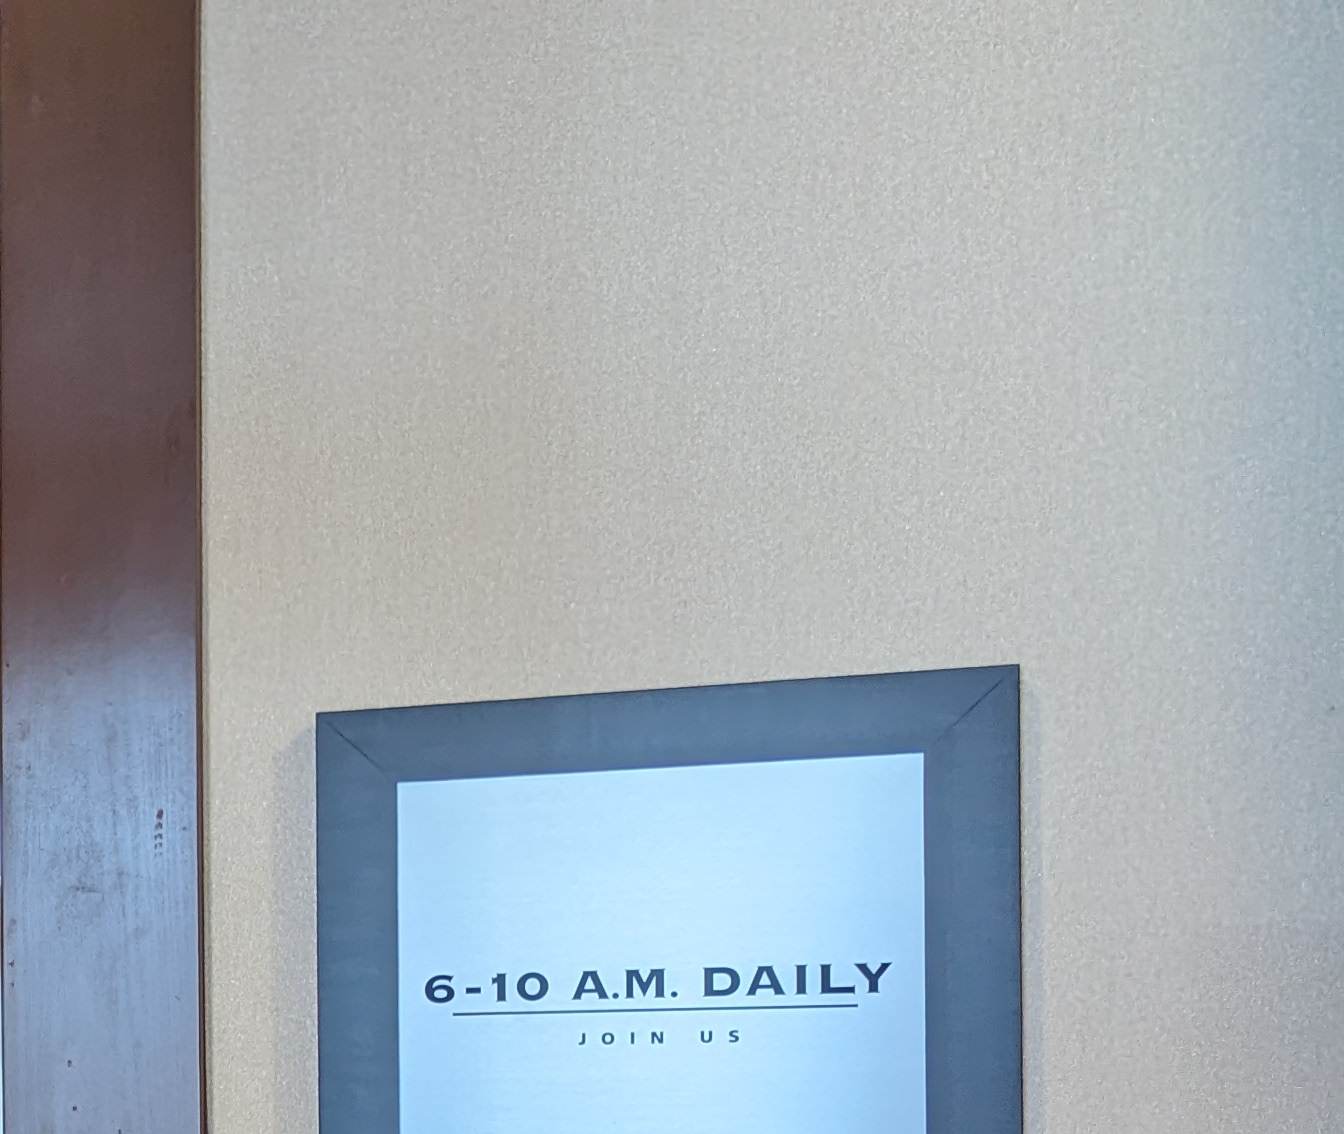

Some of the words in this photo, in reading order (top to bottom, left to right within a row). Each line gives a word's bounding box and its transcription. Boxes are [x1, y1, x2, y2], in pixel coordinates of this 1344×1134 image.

[424, 972, 549, 1004] 6-10
[571, 967, 679, 1000] A.M.
[702, 961, 894, 997] DAILY
[578, 1031, 665, 1046] JOIN
[700, 1030, 741, 1044] US
